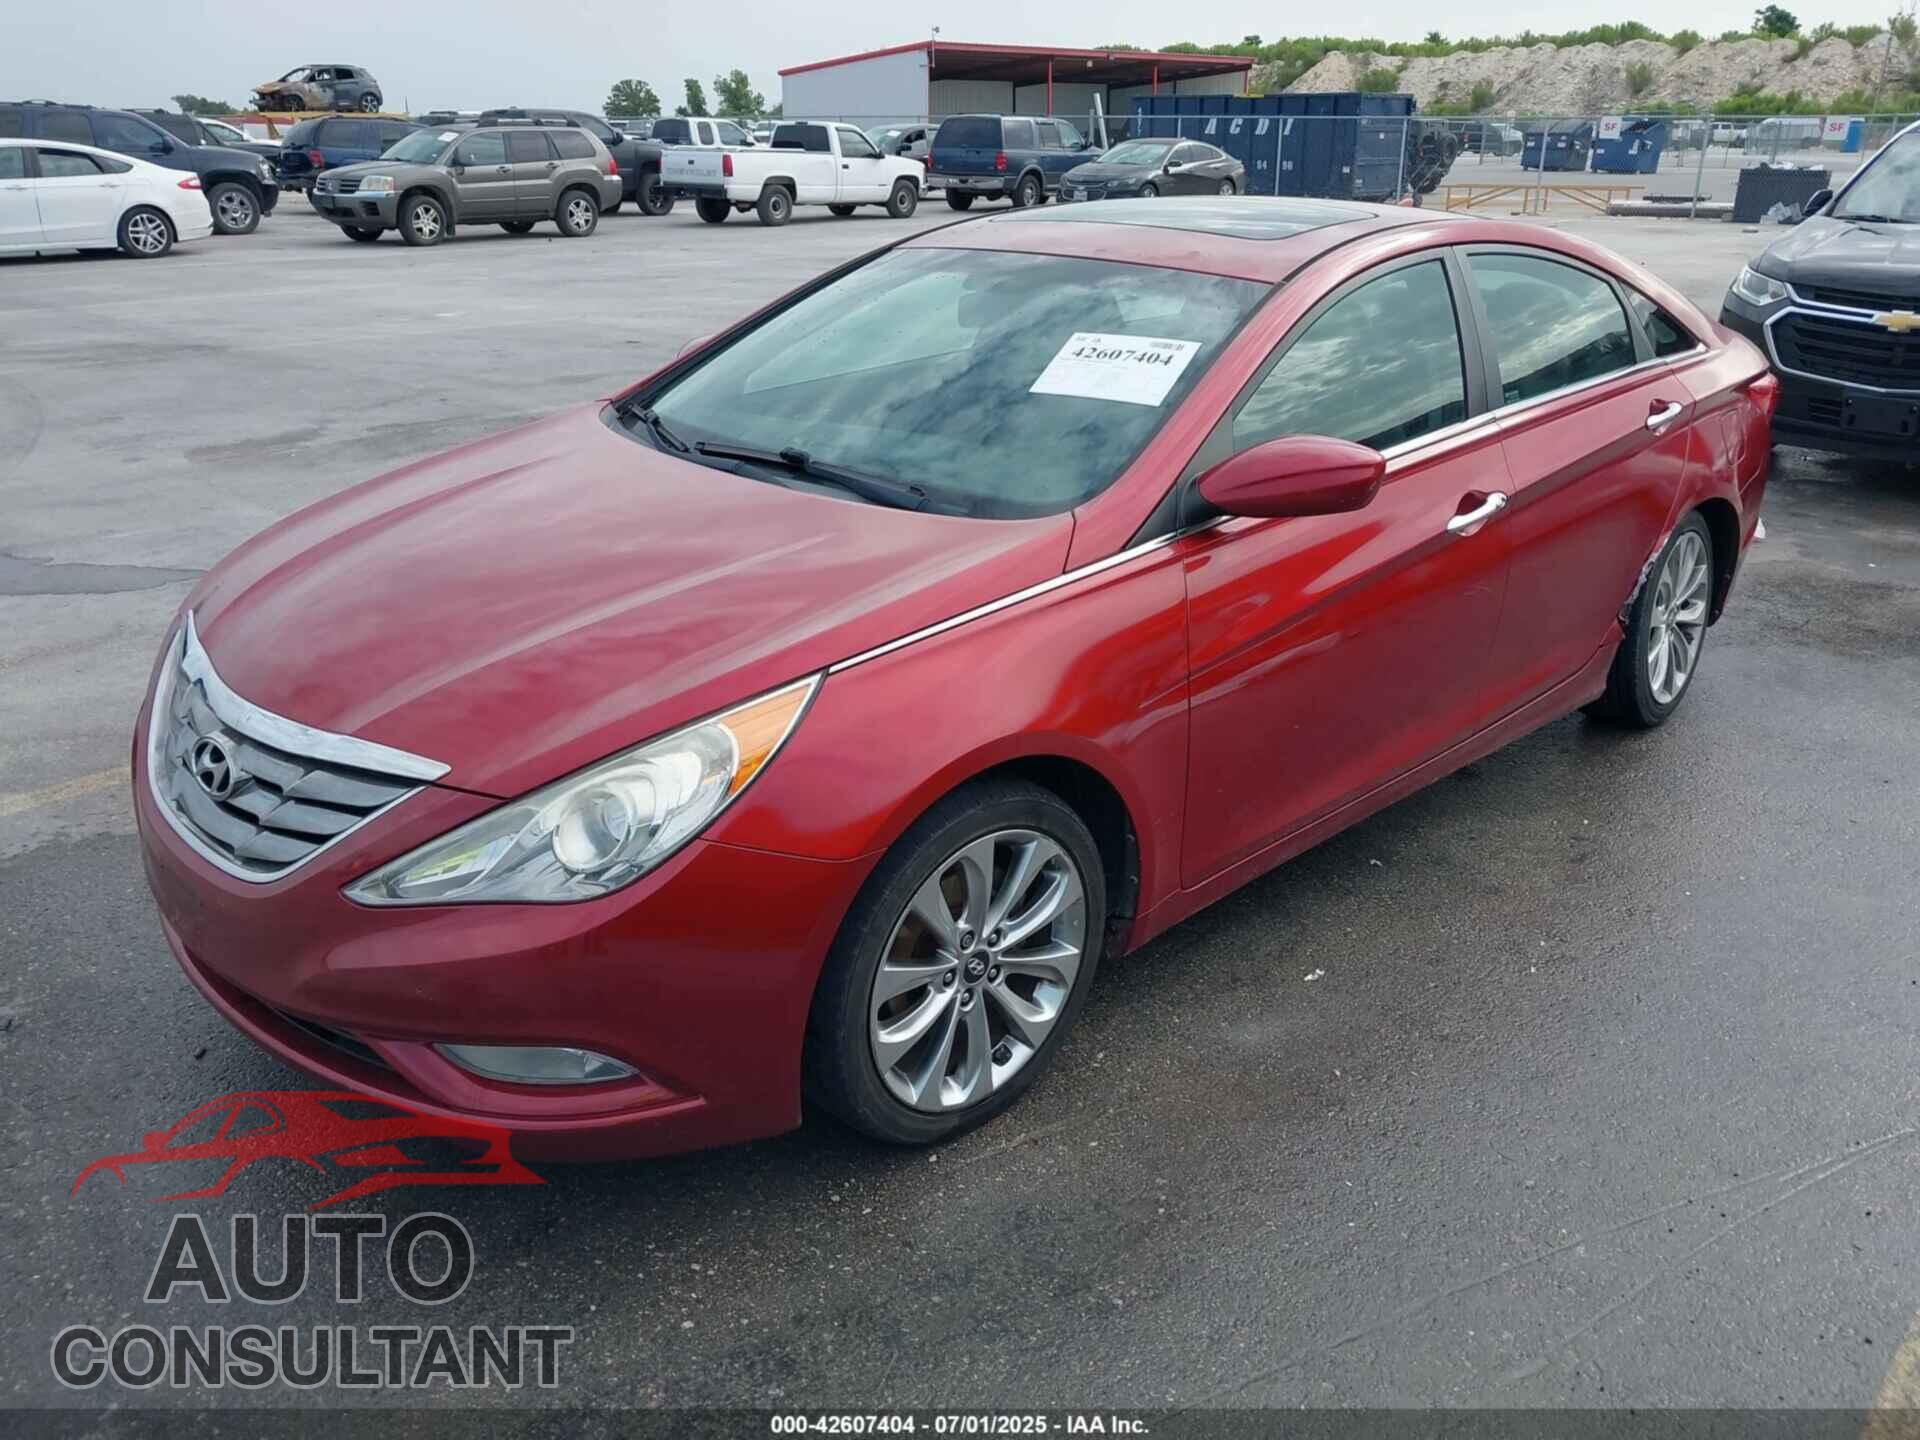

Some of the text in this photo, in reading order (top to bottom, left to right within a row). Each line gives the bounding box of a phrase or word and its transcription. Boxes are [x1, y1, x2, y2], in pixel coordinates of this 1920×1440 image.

[1604, 122, 1617, 131] SF
[1829, 122, 1845, 132] SF
[1072, 346, 1175, 366] 42607404
